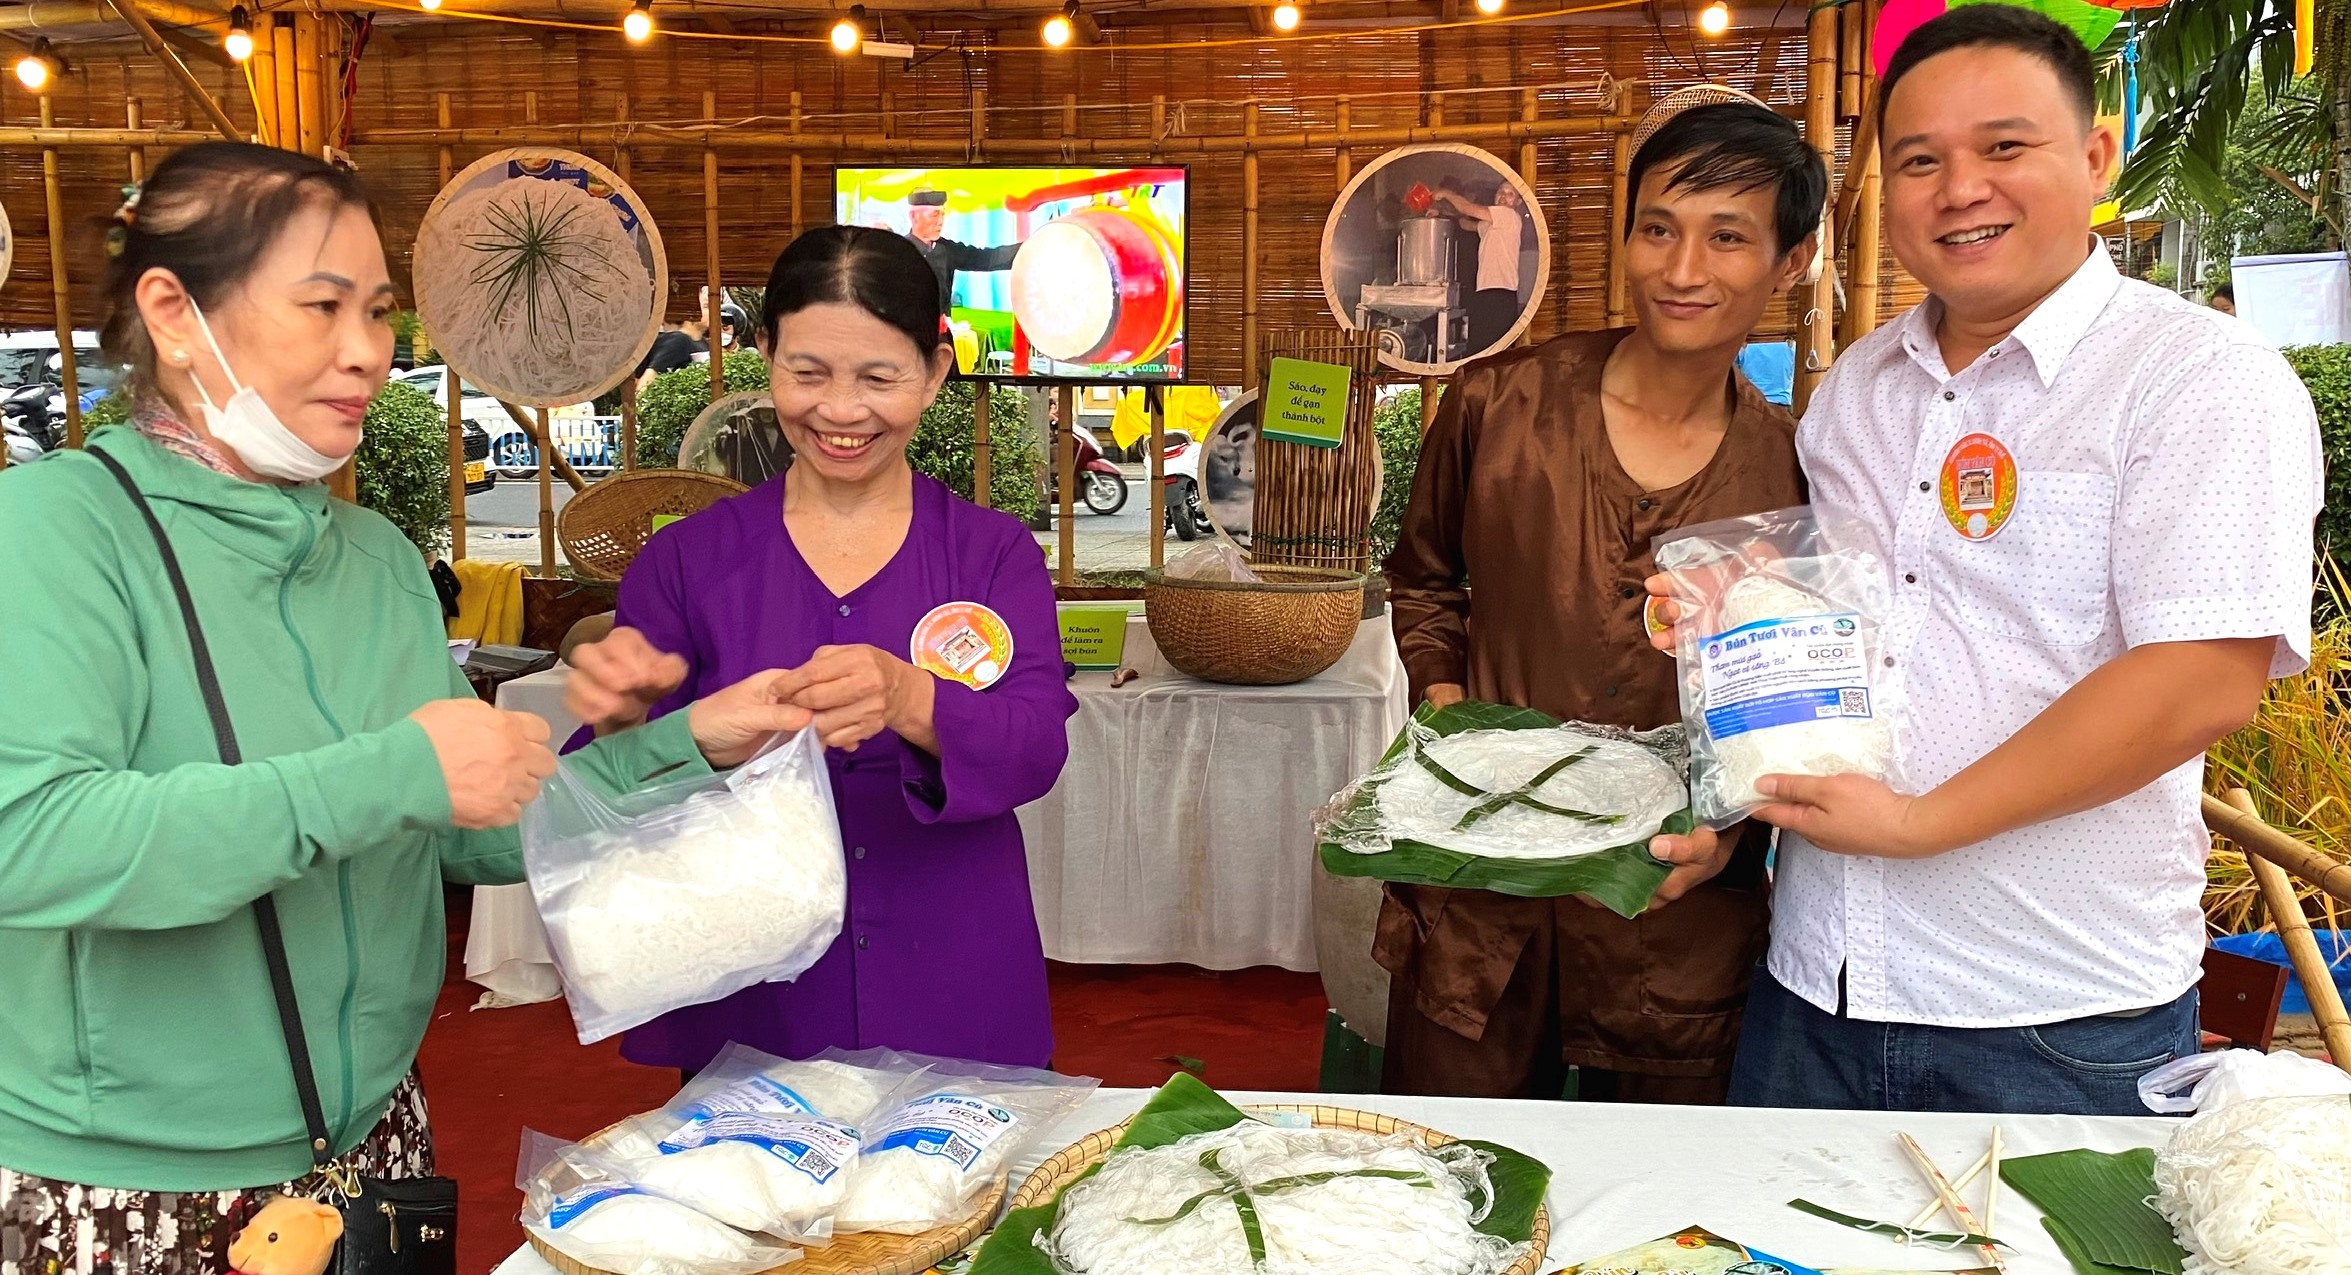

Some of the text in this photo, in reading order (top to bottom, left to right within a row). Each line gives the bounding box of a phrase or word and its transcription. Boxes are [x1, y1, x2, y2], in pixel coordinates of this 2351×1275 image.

[1128, 184, 1166, 198] TRT
[1725, 638, 1747, 651] Bún
[1748, 628, 1777, 643] Tươi
[1780, 627, 1807, 637] Vân
[1807, 647, 1856, 659] OCOP
[948, 1109, 996, 1129] OCOP
